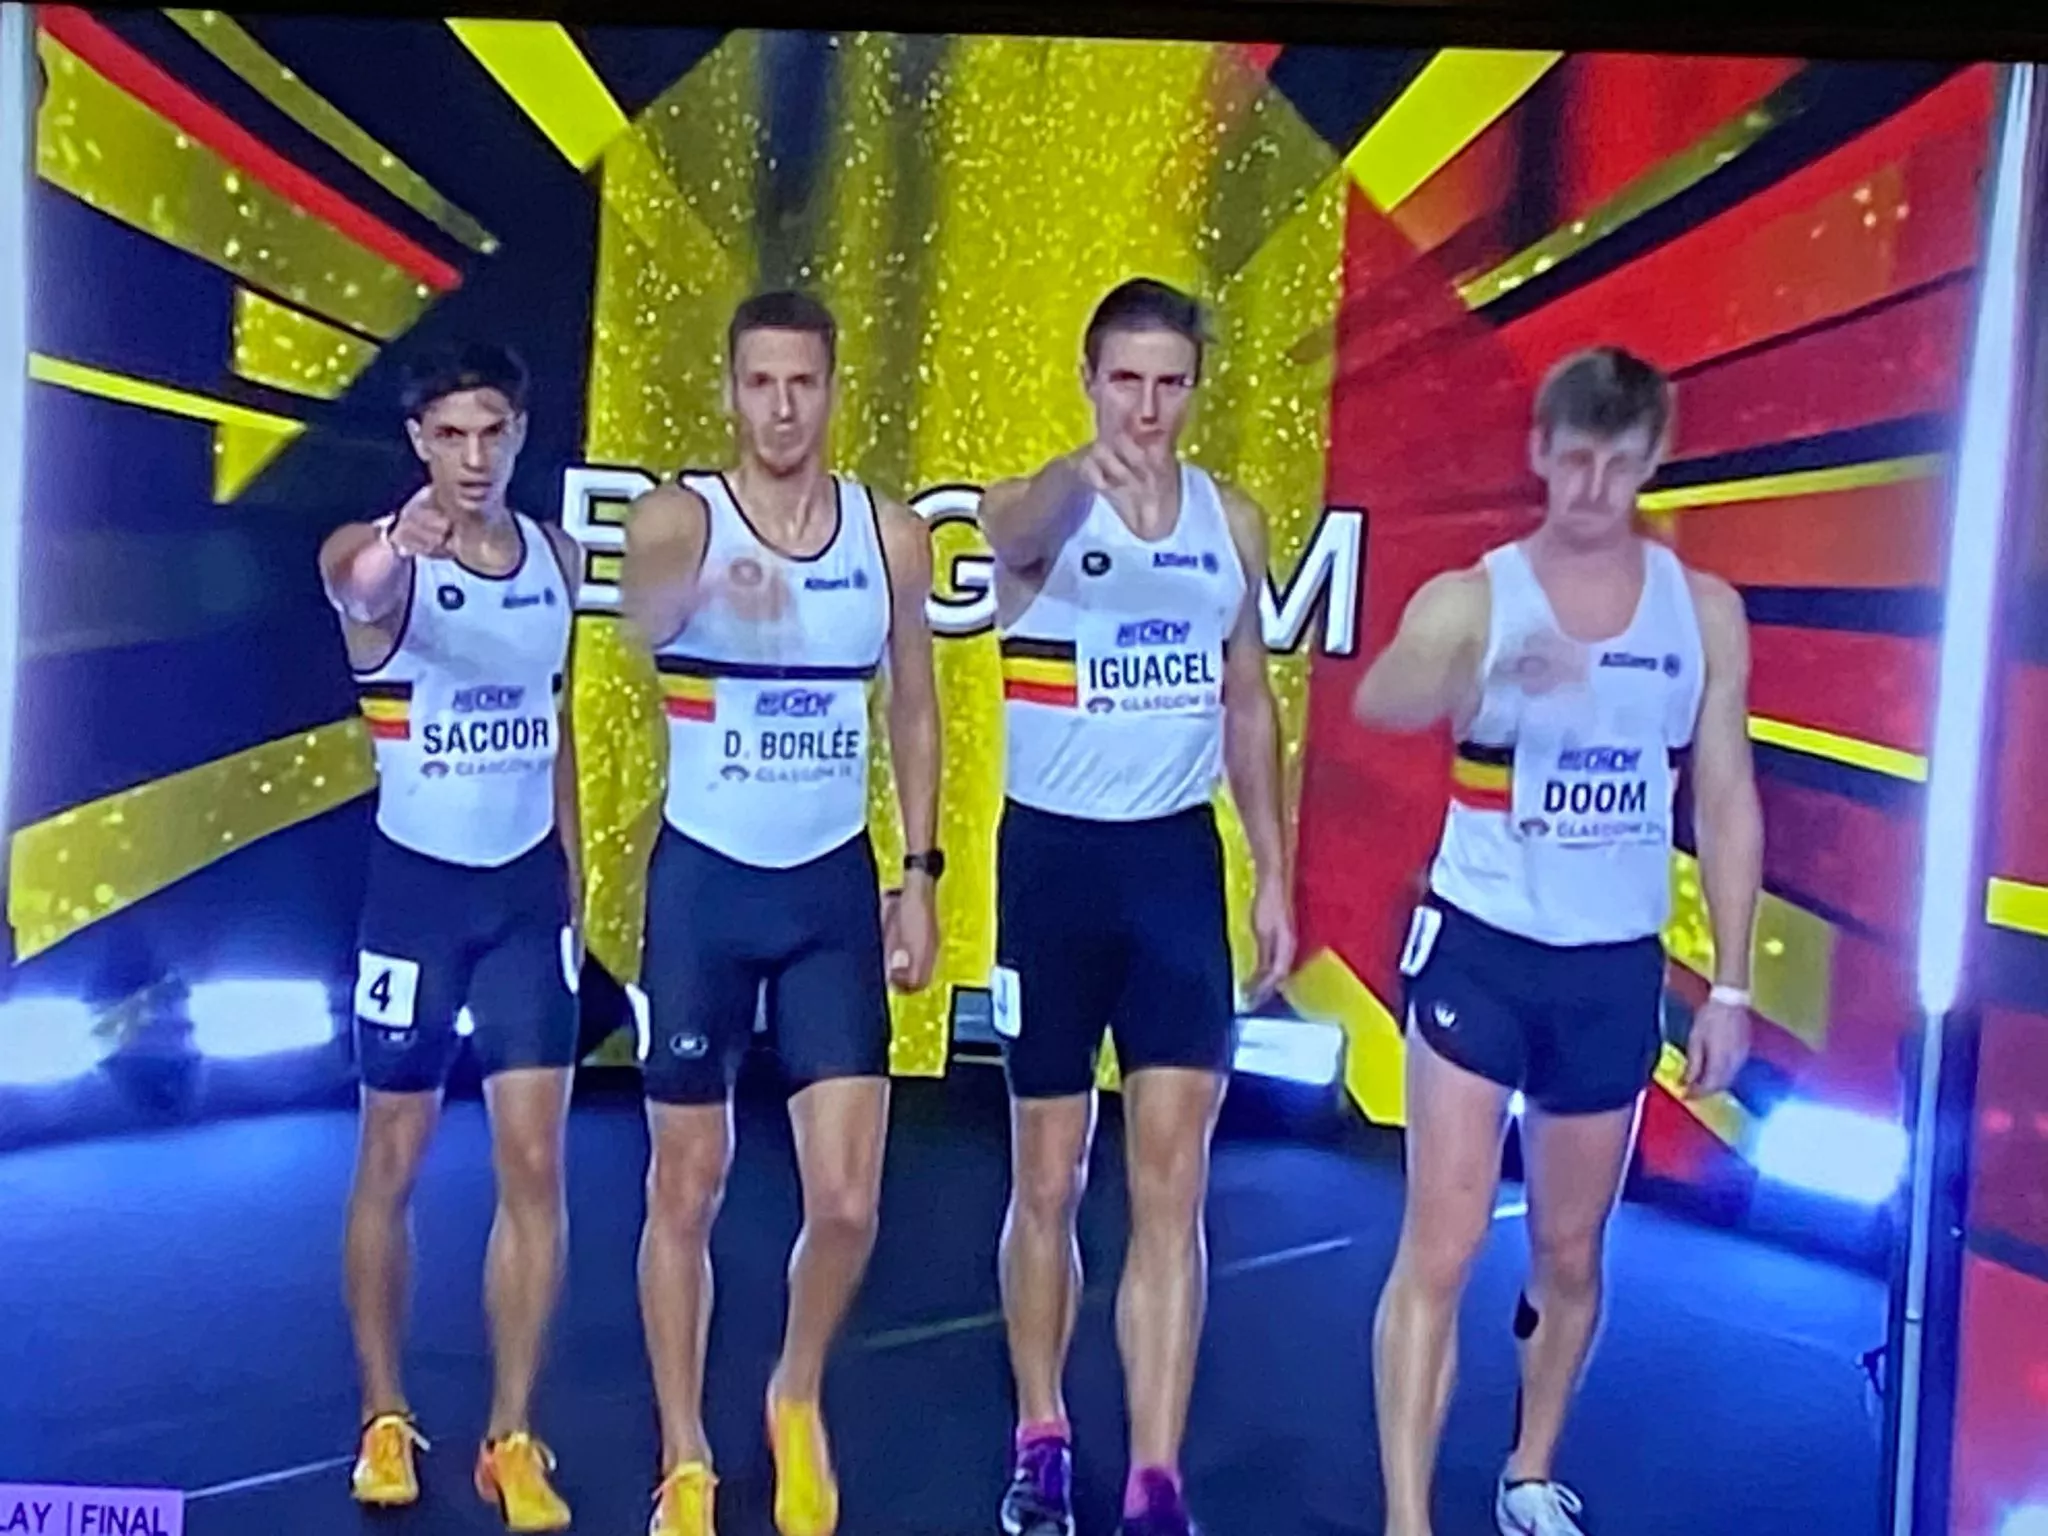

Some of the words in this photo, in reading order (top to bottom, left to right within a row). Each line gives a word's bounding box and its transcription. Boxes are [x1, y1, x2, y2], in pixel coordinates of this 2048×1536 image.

[1089, 651, 1215, 690] IGUACEL
[423, 717, 549, 755] SACOOR
[724, 730, 750, 760] D.
[760, 722, 861, 760] BORLÉE
[1544, 779, 1647, 815] DOOM
[369, 967, 392, 1013] 4
[81, 1503, 169, 1536] FINAL
